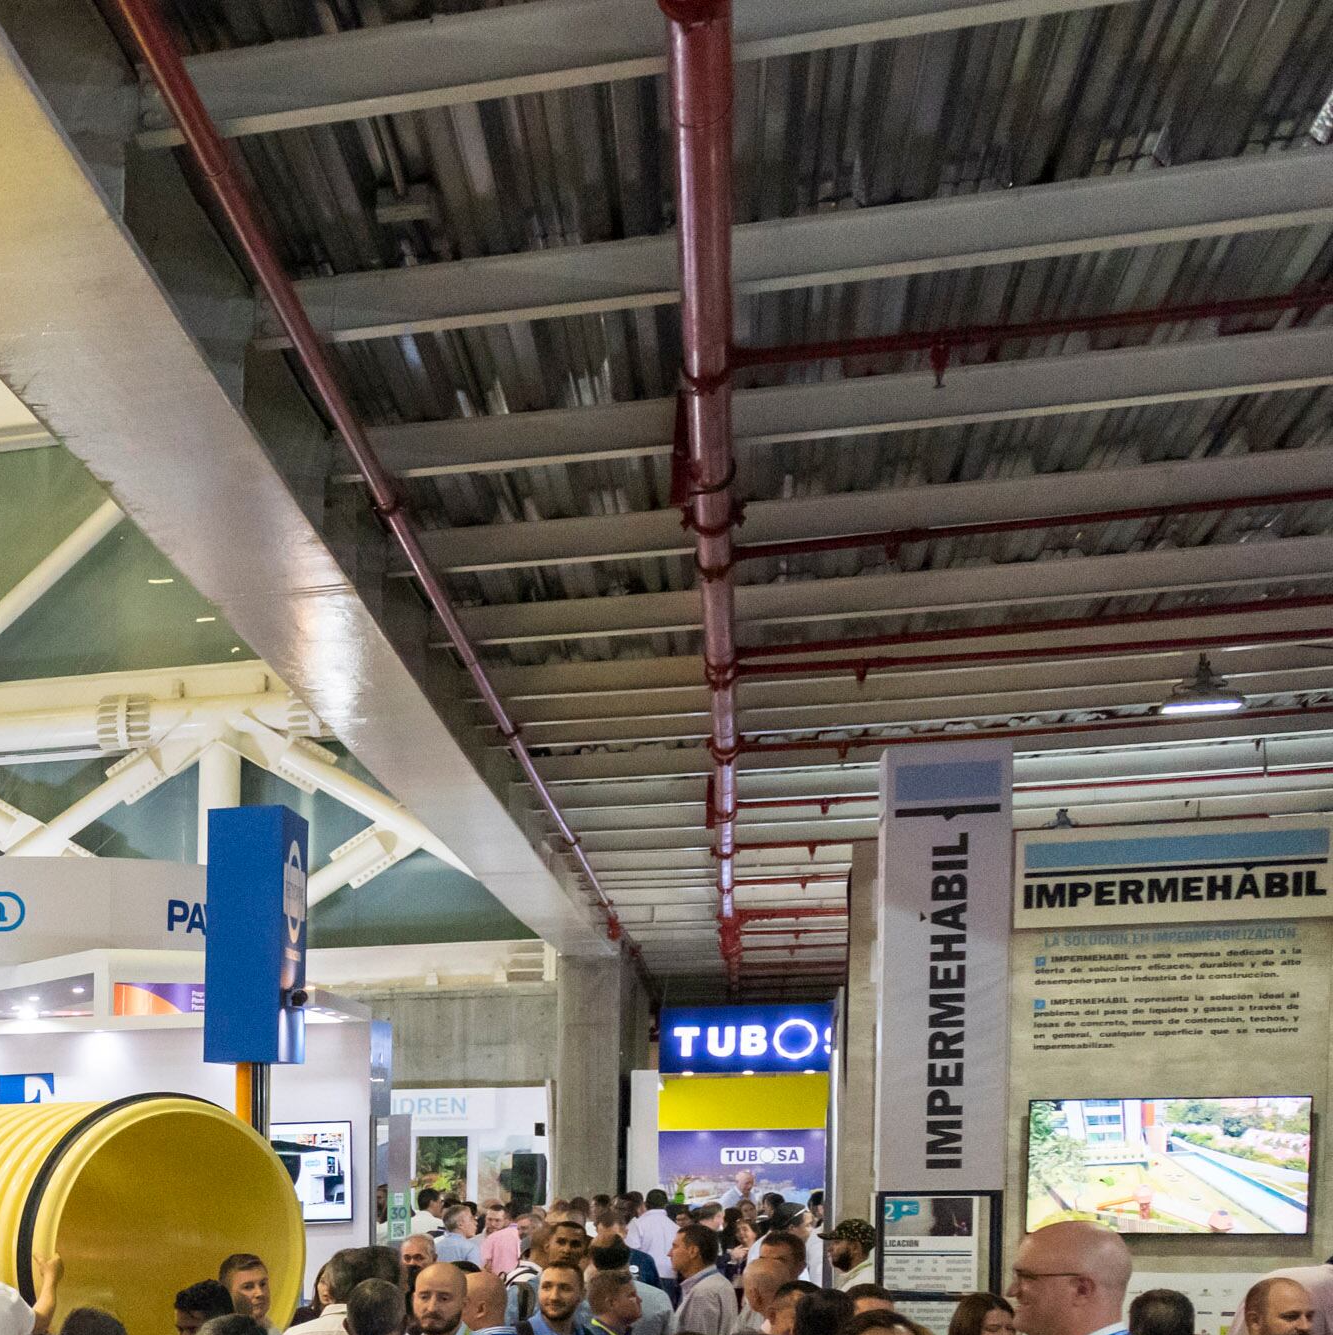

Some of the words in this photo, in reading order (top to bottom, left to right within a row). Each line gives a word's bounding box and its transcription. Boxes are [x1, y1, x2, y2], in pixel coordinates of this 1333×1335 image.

[1023, 863, 1327, 910] IMPERMEHÁBIL
[167, 899, 208, 936] PA
[1088, 964, 1143, 973] soluciones
[920, 831, 970, 1170] IMPERMEHÁBIL
[391, 1206, 408, 1219] 30
